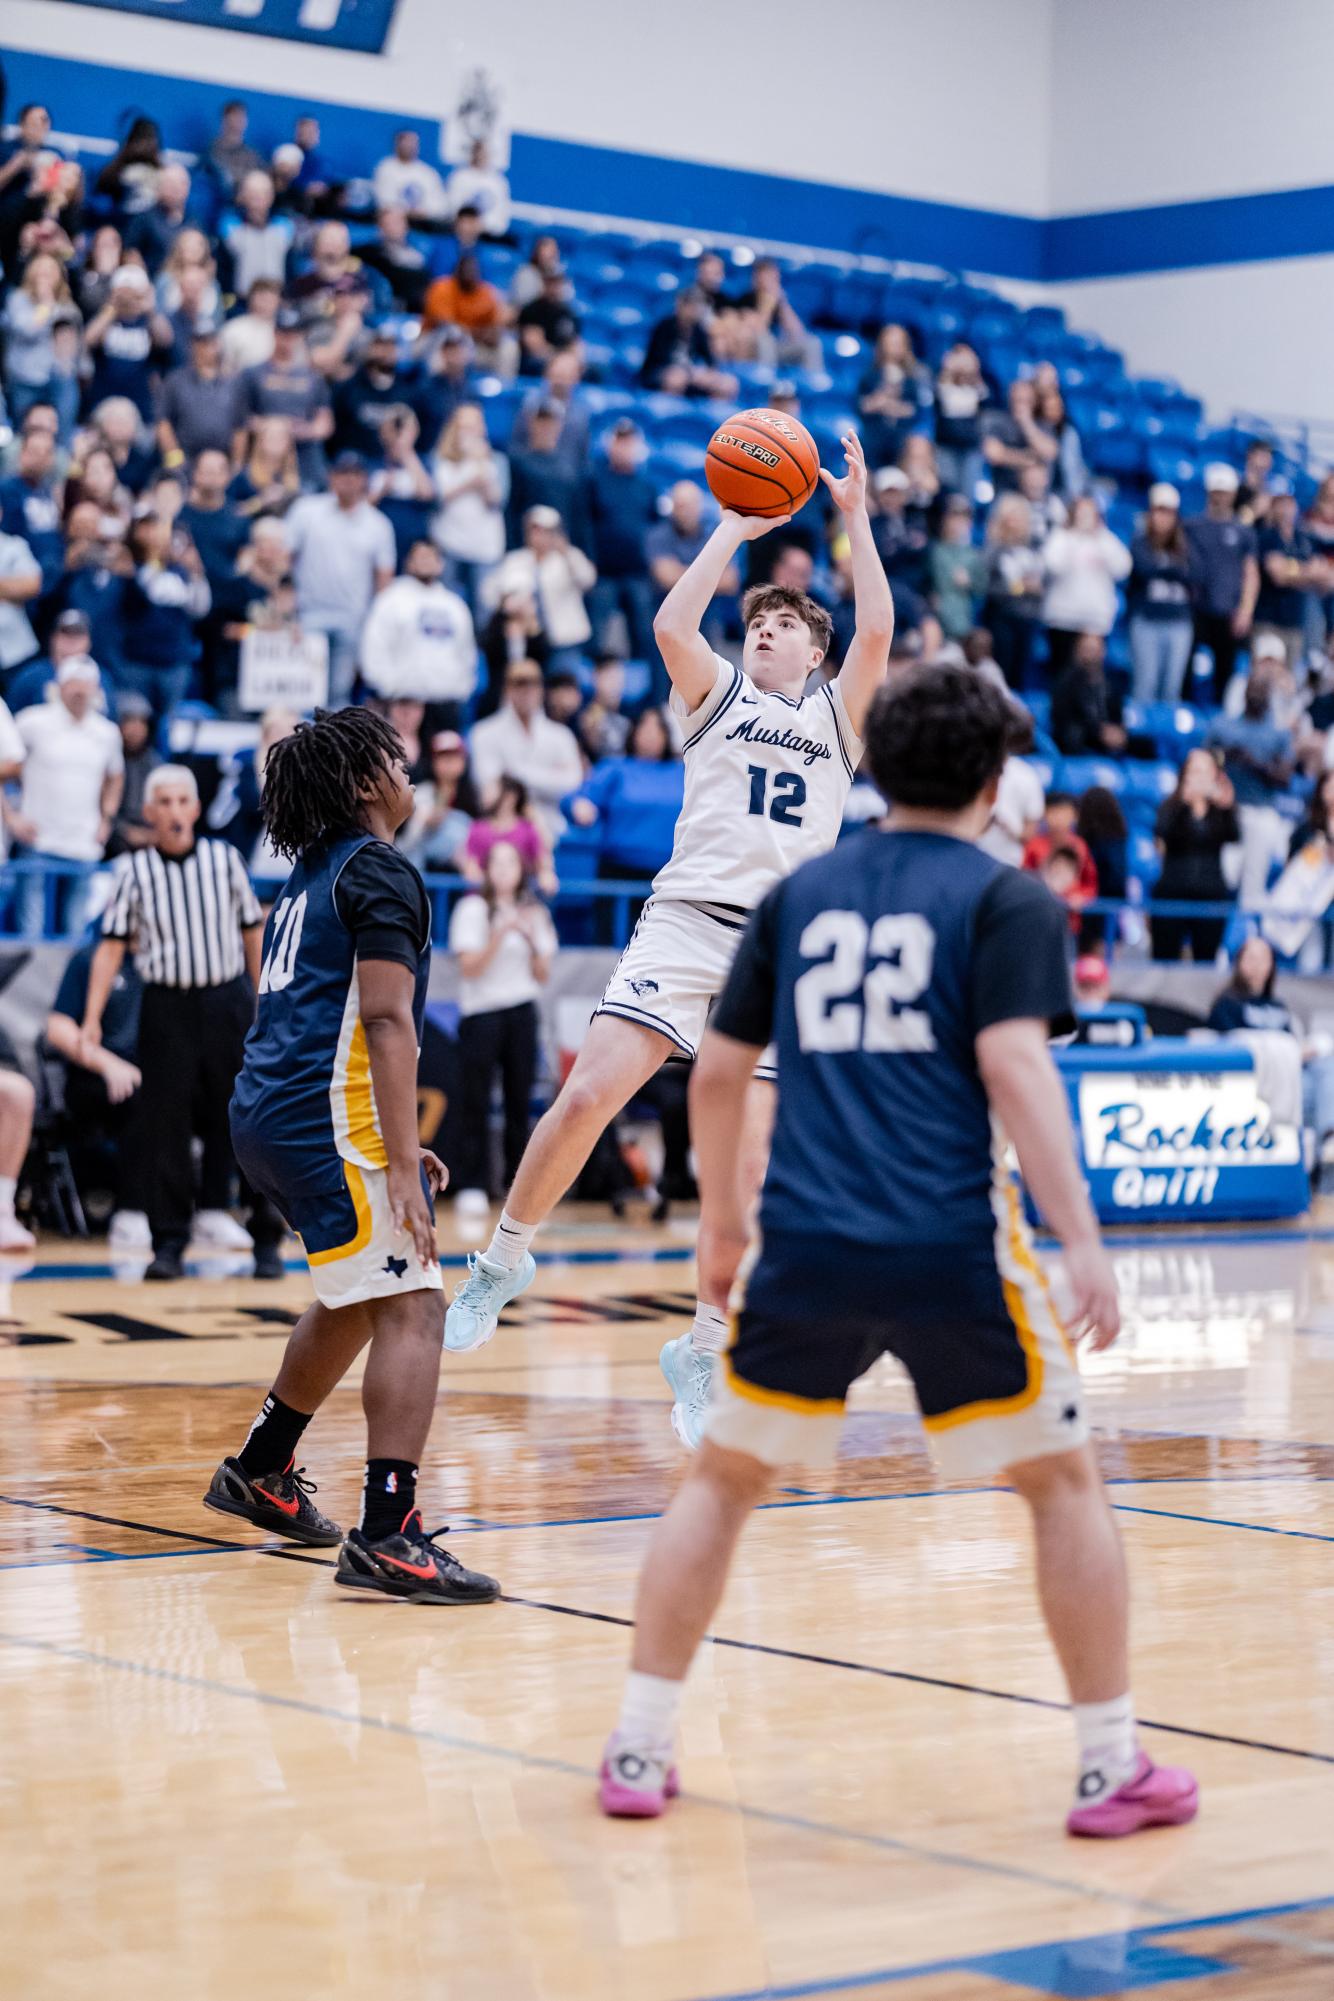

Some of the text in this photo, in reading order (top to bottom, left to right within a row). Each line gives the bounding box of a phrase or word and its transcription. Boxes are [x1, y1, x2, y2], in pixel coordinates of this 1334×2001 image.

[726, 715, 832, 766] Mustangs
[747, 763, 807, 828] 12
[258, 890, 308, 994] 10
[794, 909, 938, 1053] 22
[1099, 1103, 1276, 1164] Rockets
